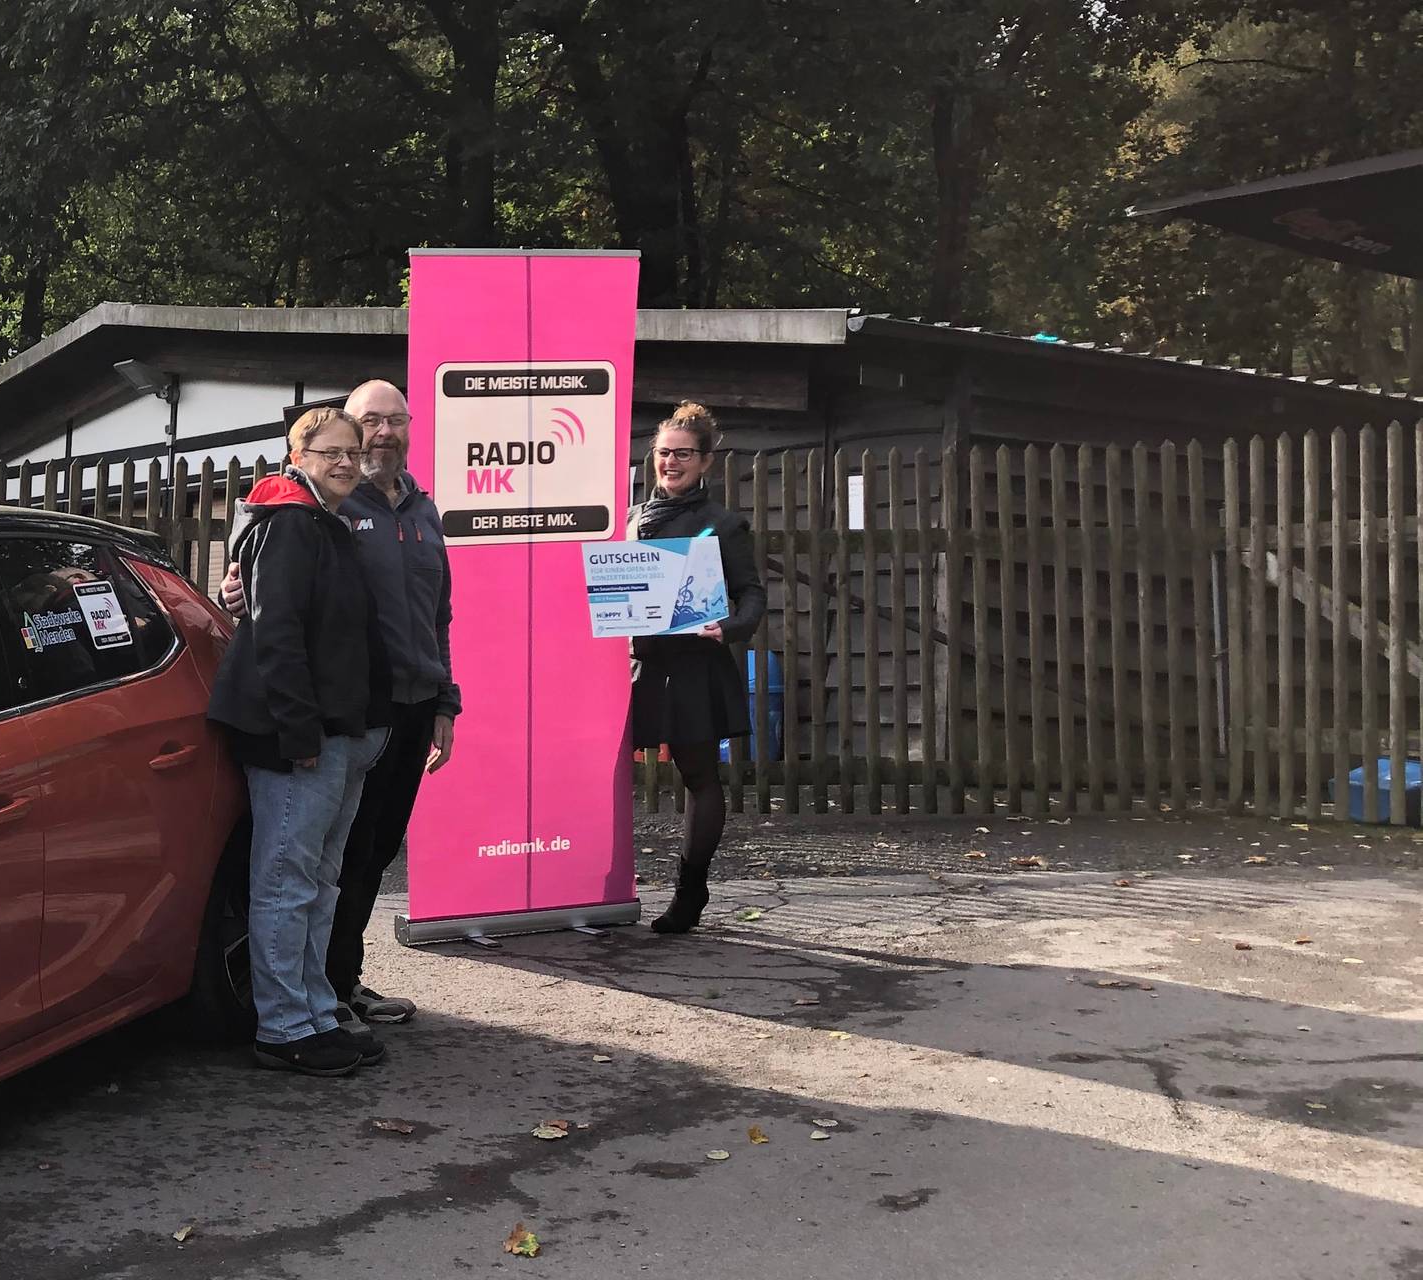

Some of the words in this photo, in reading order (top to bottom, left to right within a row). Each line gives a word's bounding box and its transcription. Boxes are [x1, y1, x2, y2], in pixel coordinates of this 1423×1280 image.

[464, 377, 486, 391] DIE
[488, 376, 538, 391] MEISTE
[540, 375, 588, 390] MUSIK.
[467, 440, 556, 467] RADIO
[466, 468, 515, 494] MK
[472, 515, 498, 529] DER
[502, 514, 544, 529] BESTE
[547, 512, 578, 527] MIX.
[589, 552, 660, 565] GUTSCHEIN
[32, 607, 83, 630] Stadtwerke
[90, 609, 112, 620] RADIO
[94, 620, 108, 630] MK
[39, 626, 77, 646] Menden
[478, 836, 571, 857] radiomk.de
